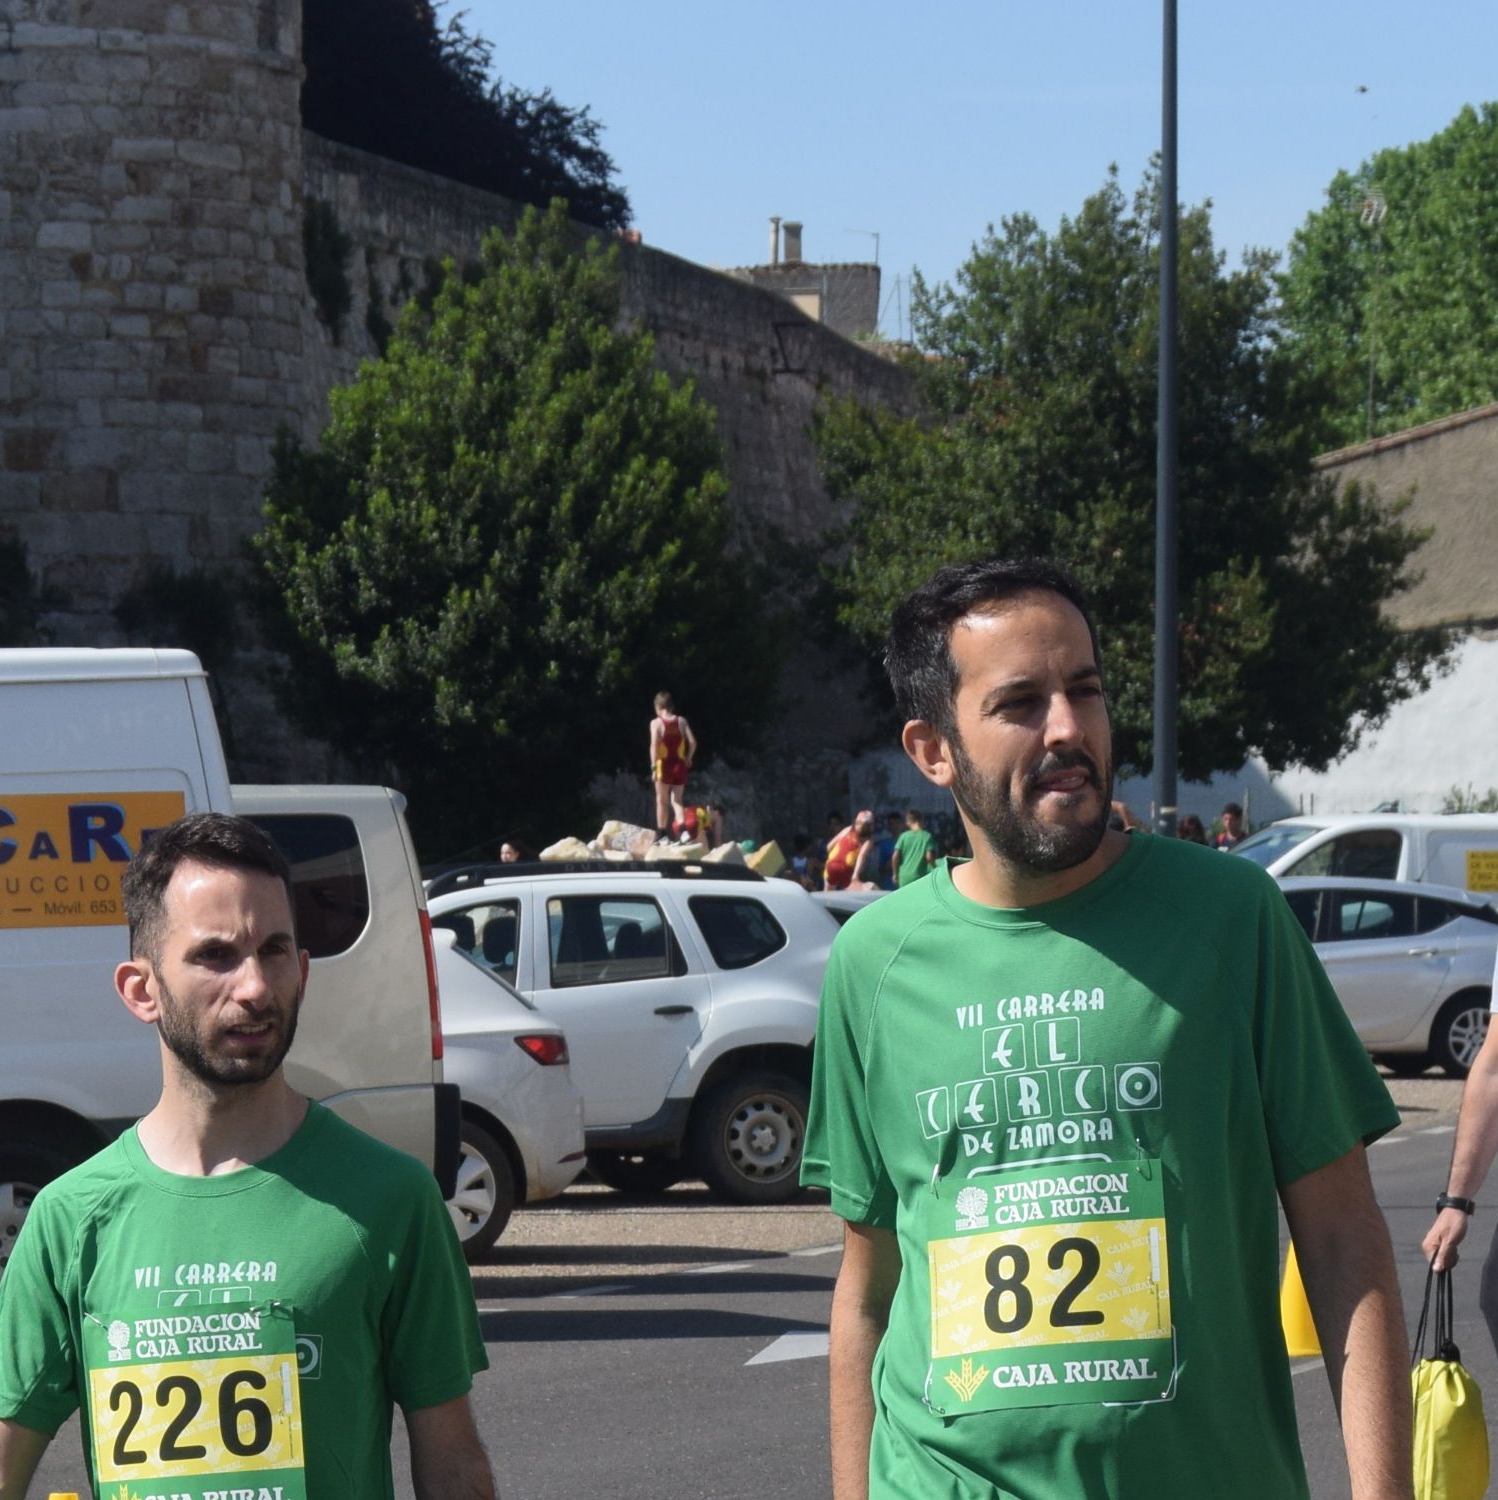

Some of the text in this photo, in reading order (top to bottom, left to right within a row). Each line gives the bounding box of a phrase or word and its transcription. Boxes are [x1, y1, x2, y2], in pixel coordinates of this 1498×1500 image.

[90, 900, 117, 914] 653
[956, 988, 1106, 1030] VII CARRERA
[963, 1118, 1113, 1157] DE ZAMORA
[995, 1173, 1128, 1202] FUNDACION
[995, 1195, 1130, 1224] CAJA RURAL
[134, 1261, 278, 1290] VII CARRERA
[983, 1236, 1105, 1335] 82
[134, 1310, 261, 1337] FUNDACION
[136, 1332, 262, 1359] CAJA RURAL
[993, 1359, 1157, 1389] CAJA RURAL
[108, 1368, 273, 1467] 226
